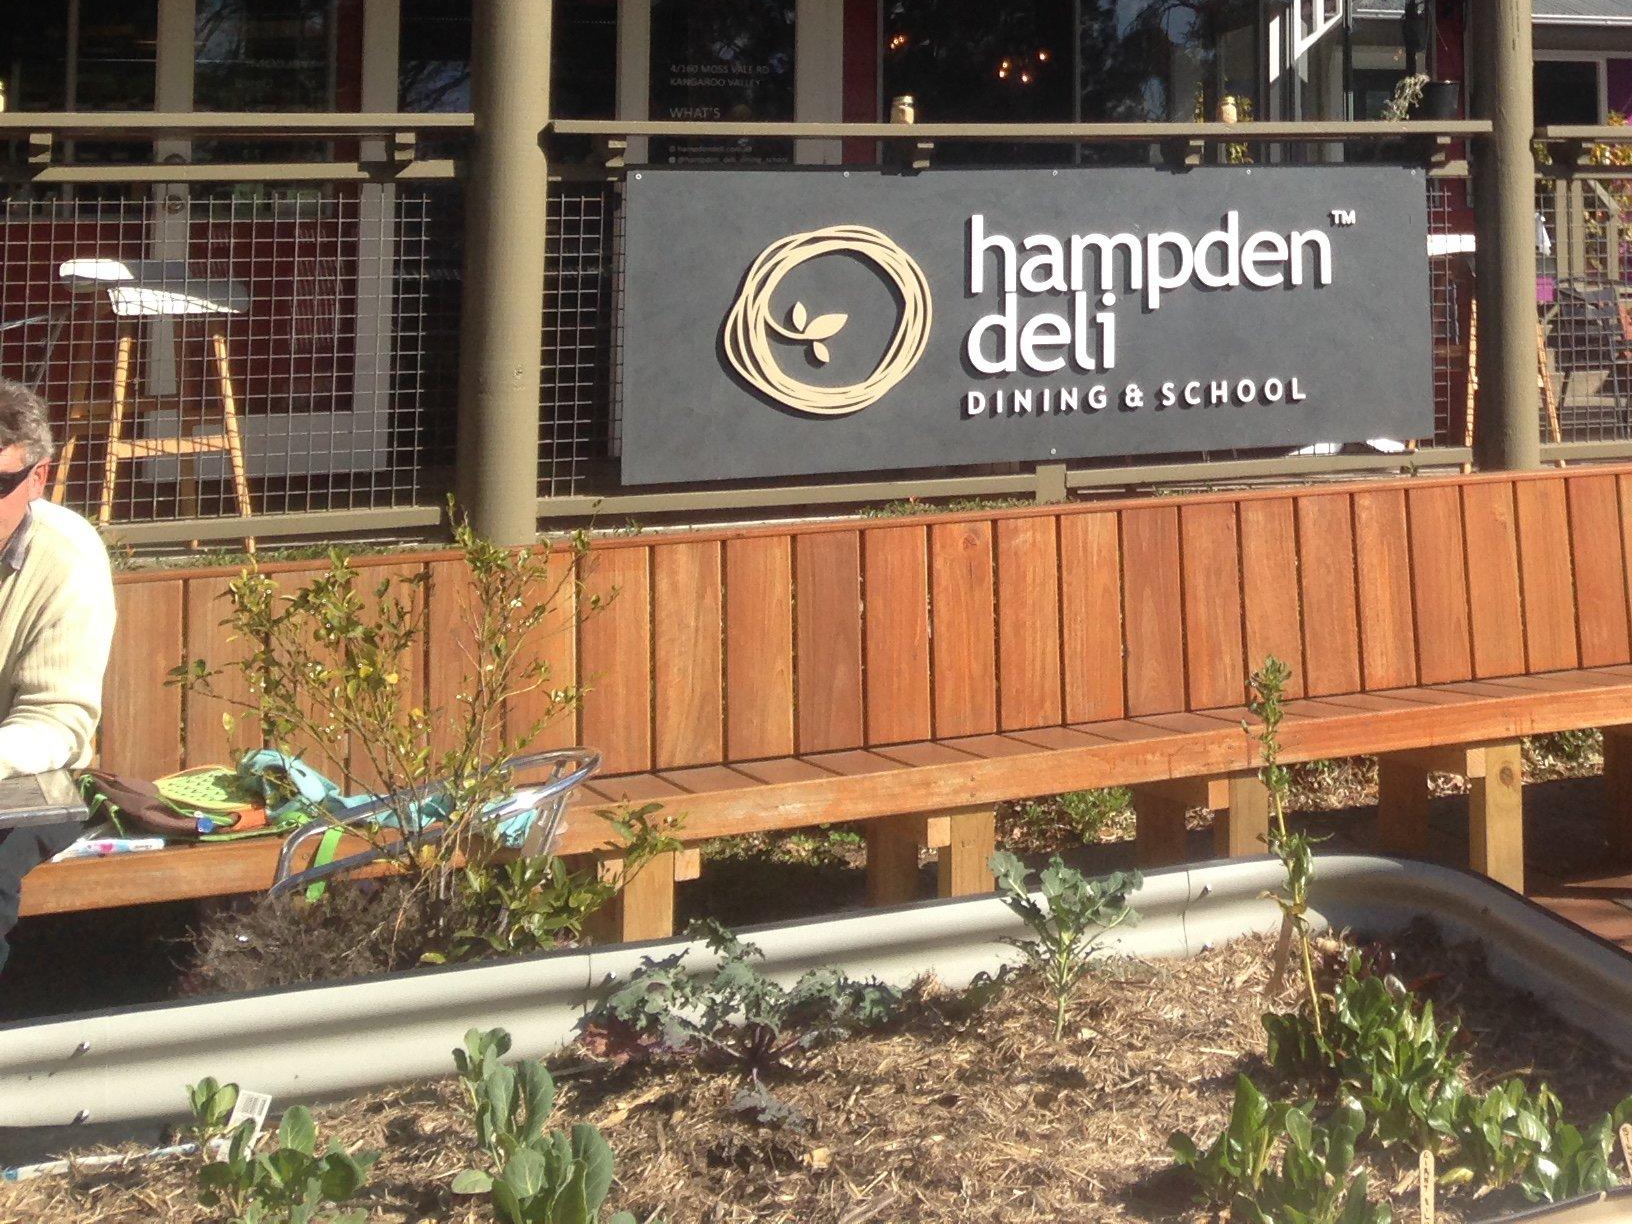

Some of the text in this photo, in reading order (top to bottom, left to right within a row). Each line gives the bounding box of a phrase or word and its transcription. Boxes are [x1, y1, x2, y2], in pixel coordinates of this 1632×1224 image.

[669, 107, 721, 118] WHAT'S
[971, 210, 1332, 309] hampden
[967, 291, 1117, 373] deli
[967, 377, 1307, 415] DINING & SCHOOL
